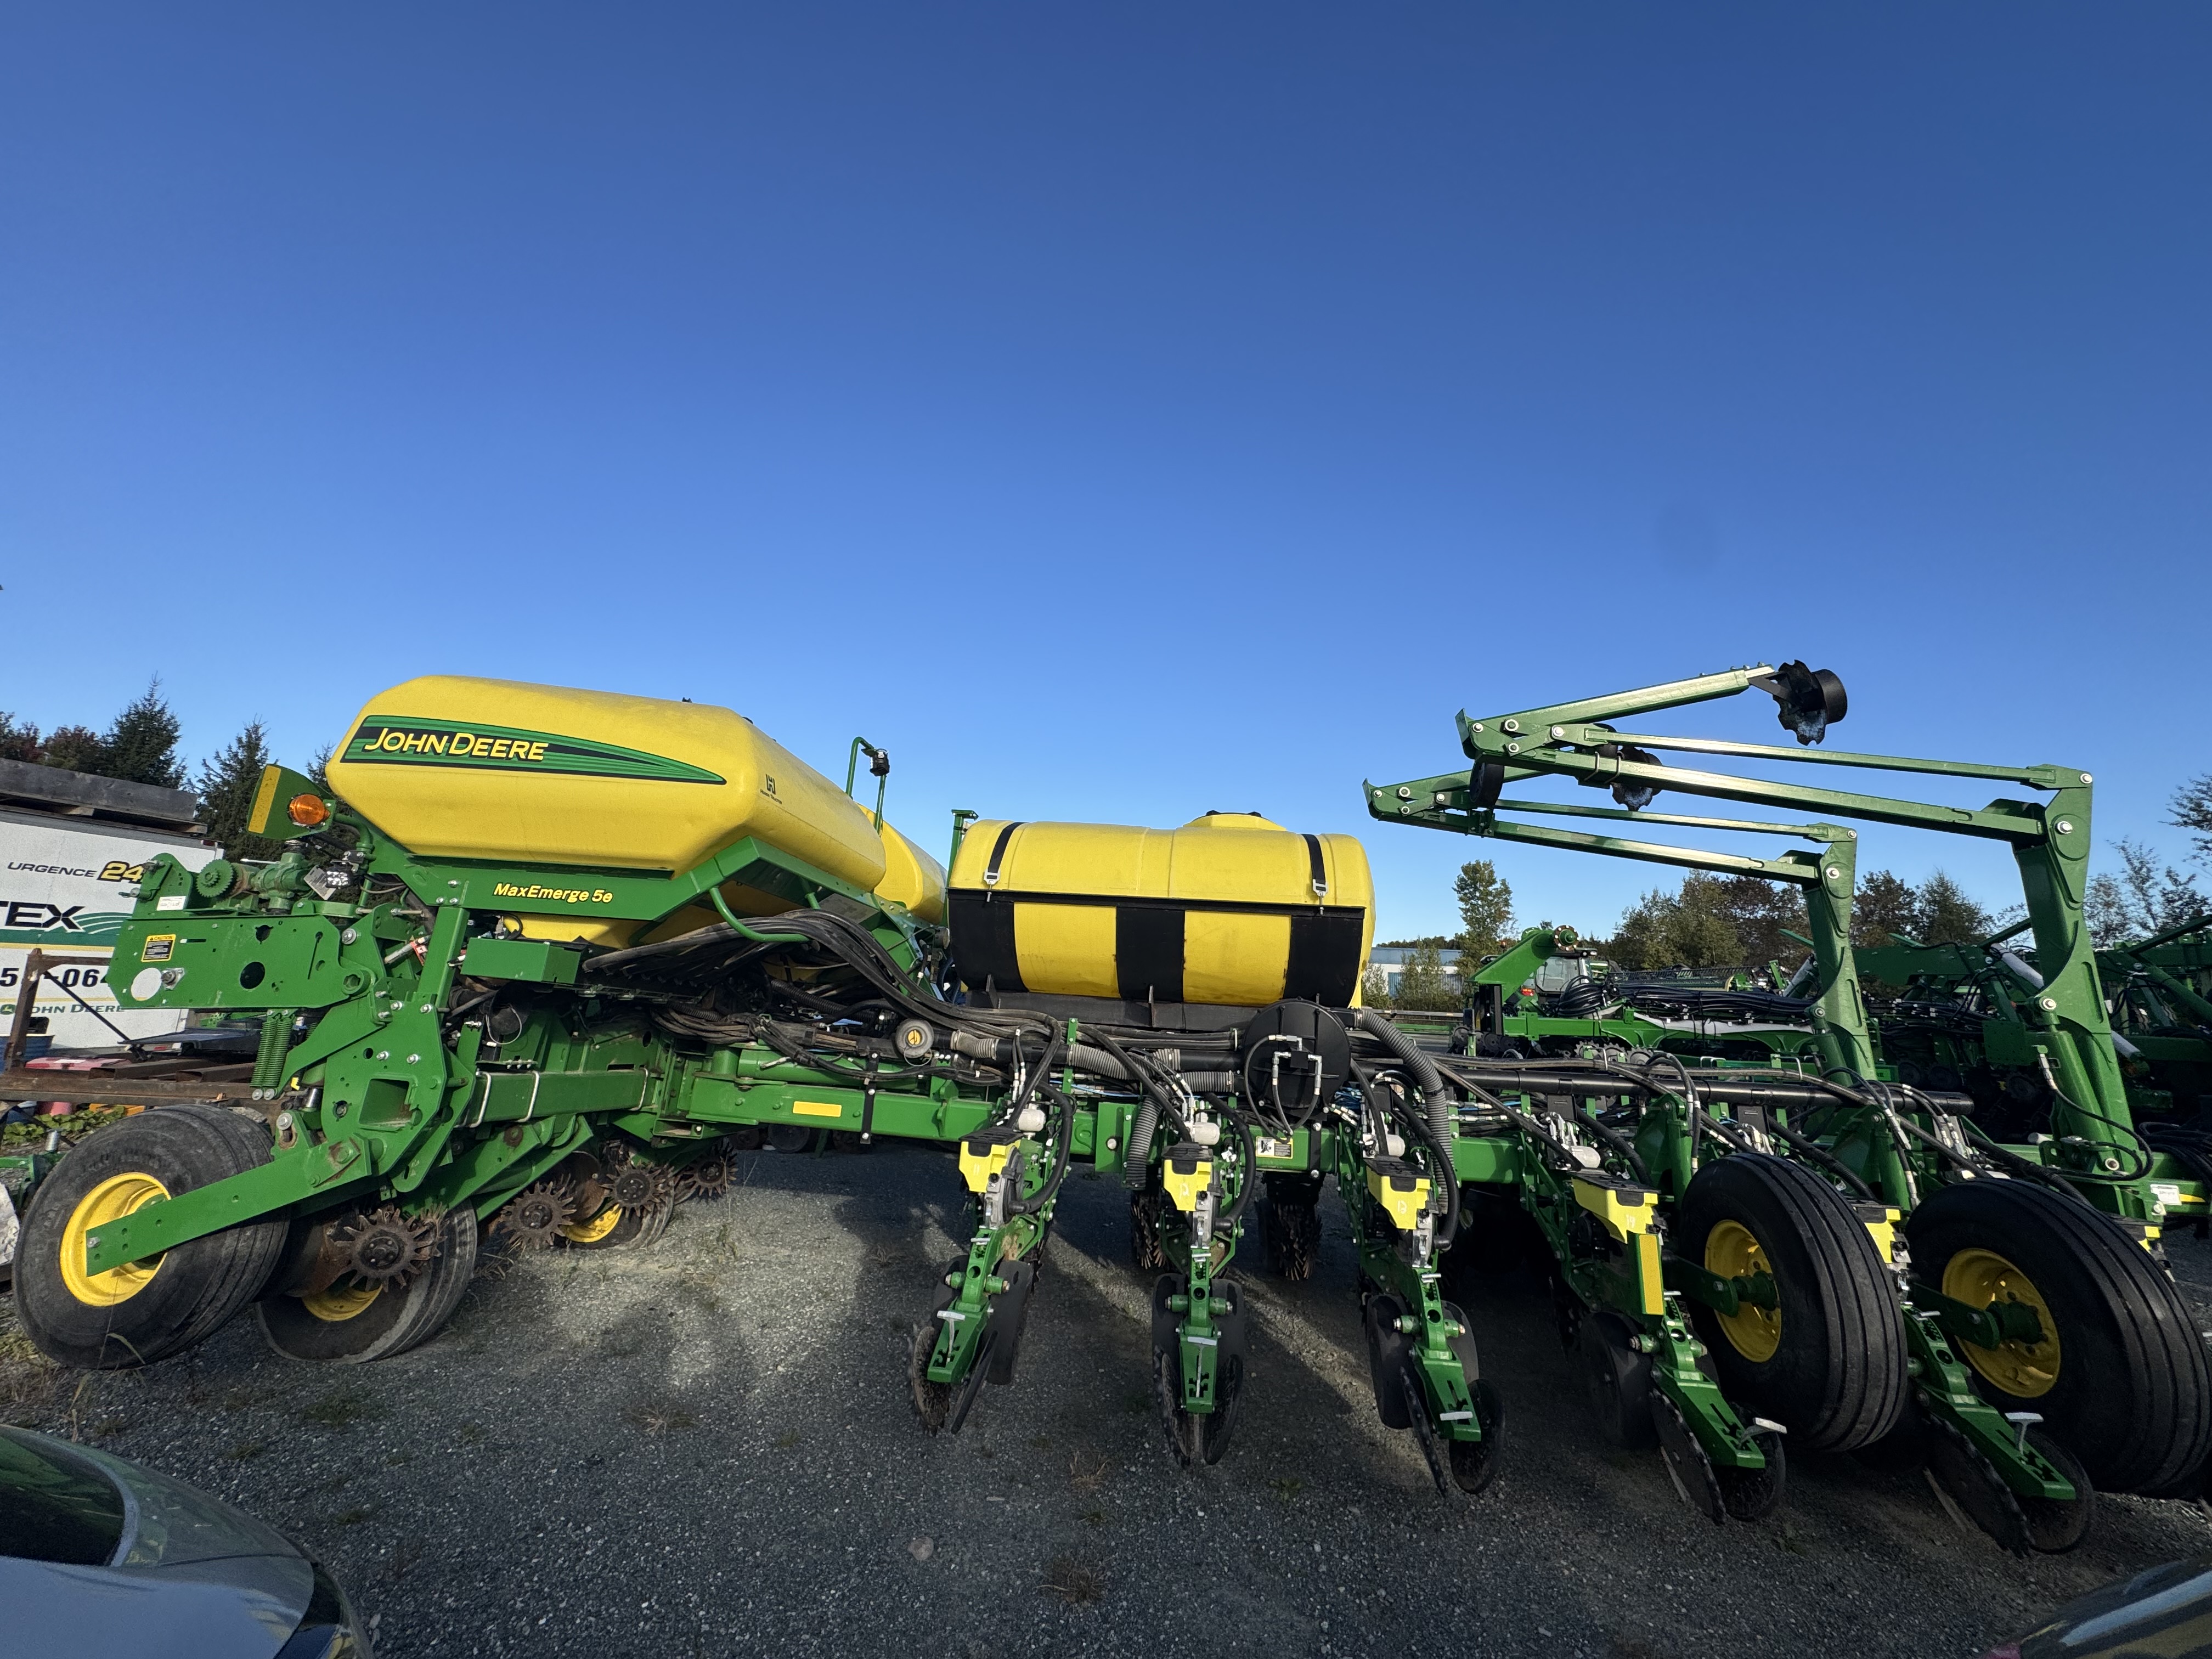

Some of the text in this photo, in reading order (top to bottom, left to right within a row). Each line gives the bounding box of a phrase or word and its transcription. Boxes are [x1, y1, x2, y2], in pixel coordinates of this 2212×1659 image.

[364, 728, 549, 761] JOHN DEERE
[7, 861, 144, 884] URGENCE 24
[493, 883, 613, 903] MaxEmerge 5e
[0, 900, 86, 931] EX
[31, 1005, 65, 1014] OHN
